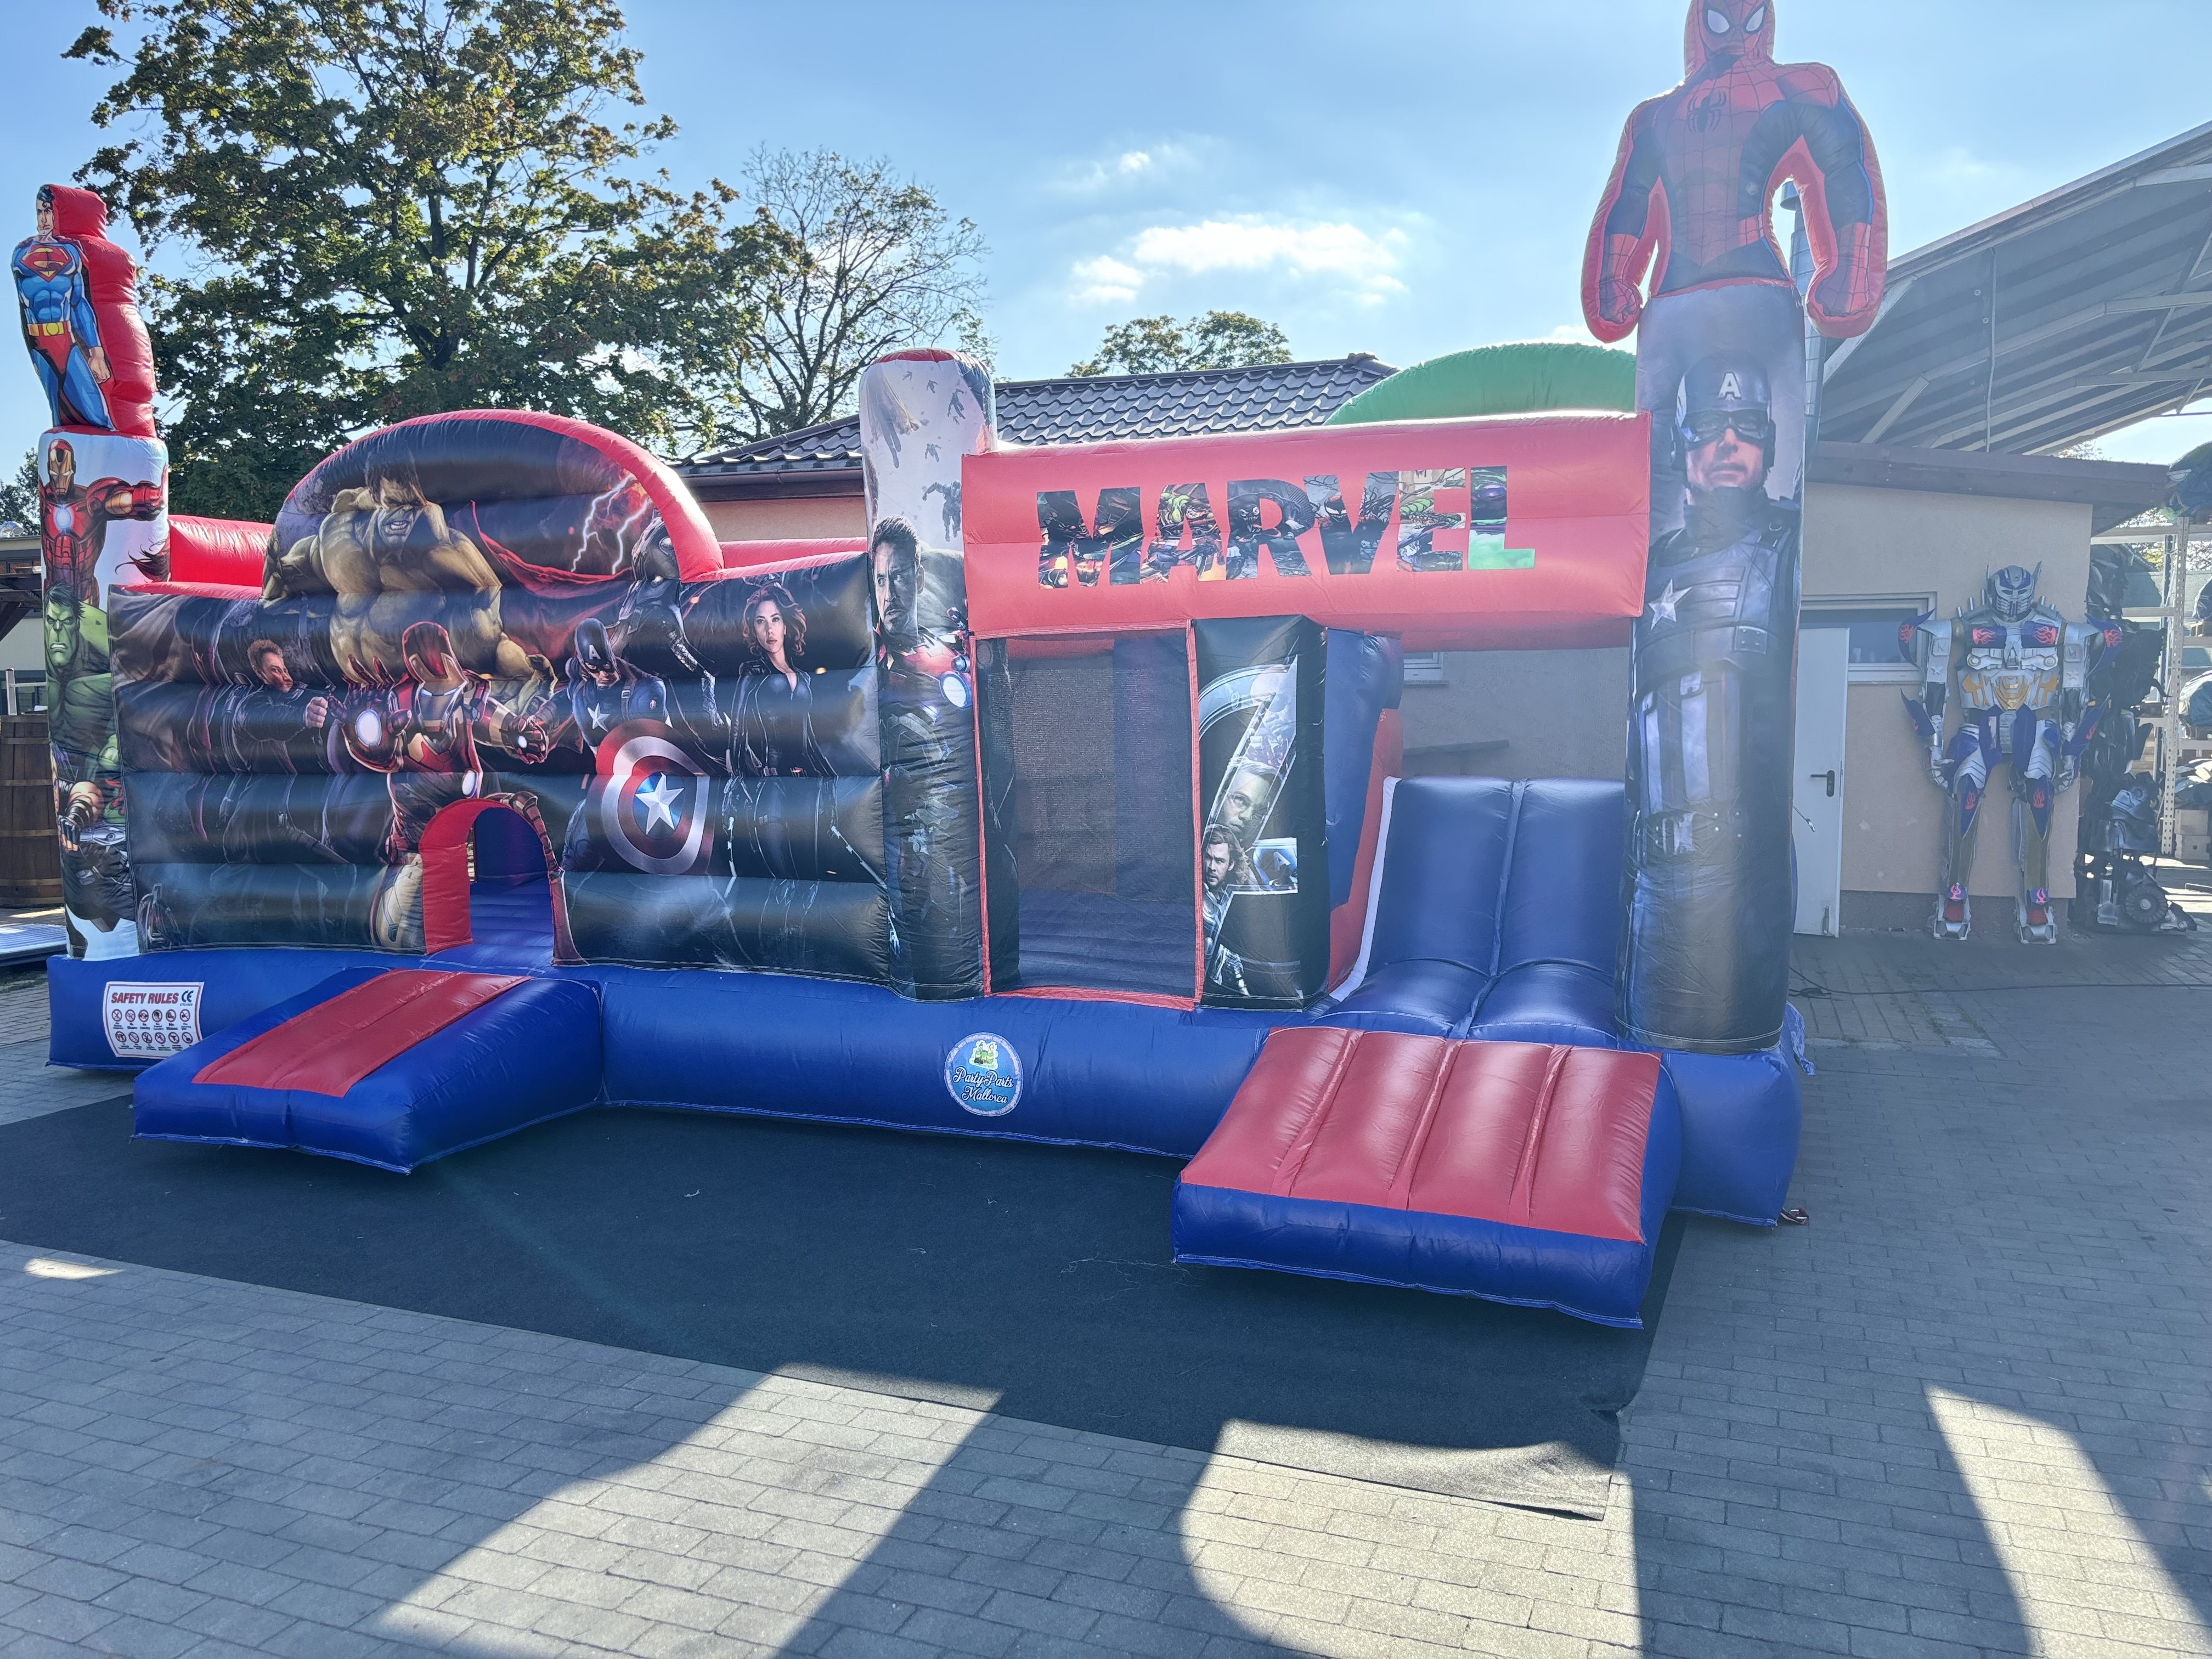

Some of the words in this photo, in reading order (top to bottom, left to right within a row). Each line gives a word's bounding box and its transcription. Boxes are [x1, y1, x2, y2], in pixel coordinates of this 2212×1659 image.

[1717, 372, 1742, 399] A
[1037, 465, 1535, 590] MARVEL
[589, 645, 601, 659] A
[111, 992, 146, 1004] SAFETY
[148, 992, 179, 1004] RULES
[182, 990, 194, 1003] CE
[961, 1085, 1008, 1103] Mallorca
